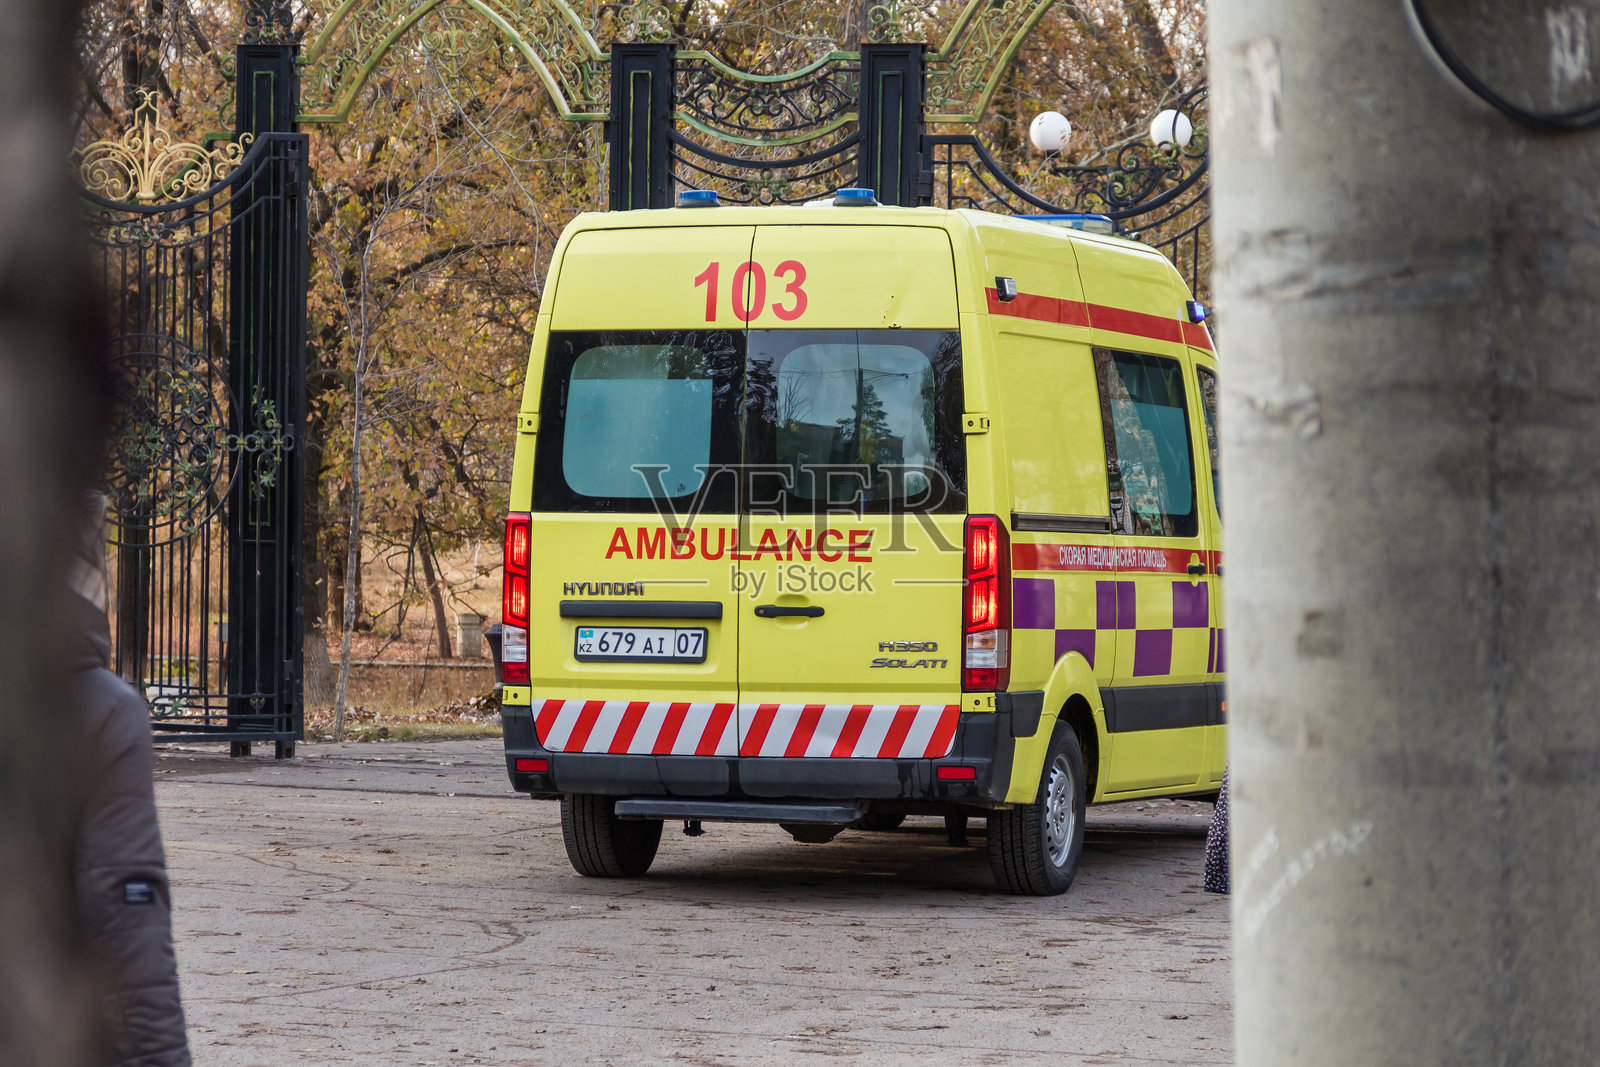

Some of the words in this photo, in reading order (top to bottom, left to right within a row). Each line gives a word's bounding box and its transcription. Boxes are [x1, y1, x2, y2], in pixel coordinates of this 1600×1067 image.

[694, 260, 808, 322] 103
[605, 527, 874, 562] AMBULANCE
[1059, 546, 1087, 565] СКОРАЯ
[1088, 548, 1137, 569] МЕДИЦИНСКАЯ
[1138, 550, 1167, 570] ПОМОЩЬ
[563, 581, 645, 596] HYUNDAI
[579, 643, 592, 653] KZ
[598, 632, 636, 653] 679
[642, 637, 665, 654] AI
[677, 633, 703, 654] 07
[878, 640, 938, 652] H350
[869, 657, 948, 669] SOLATI
